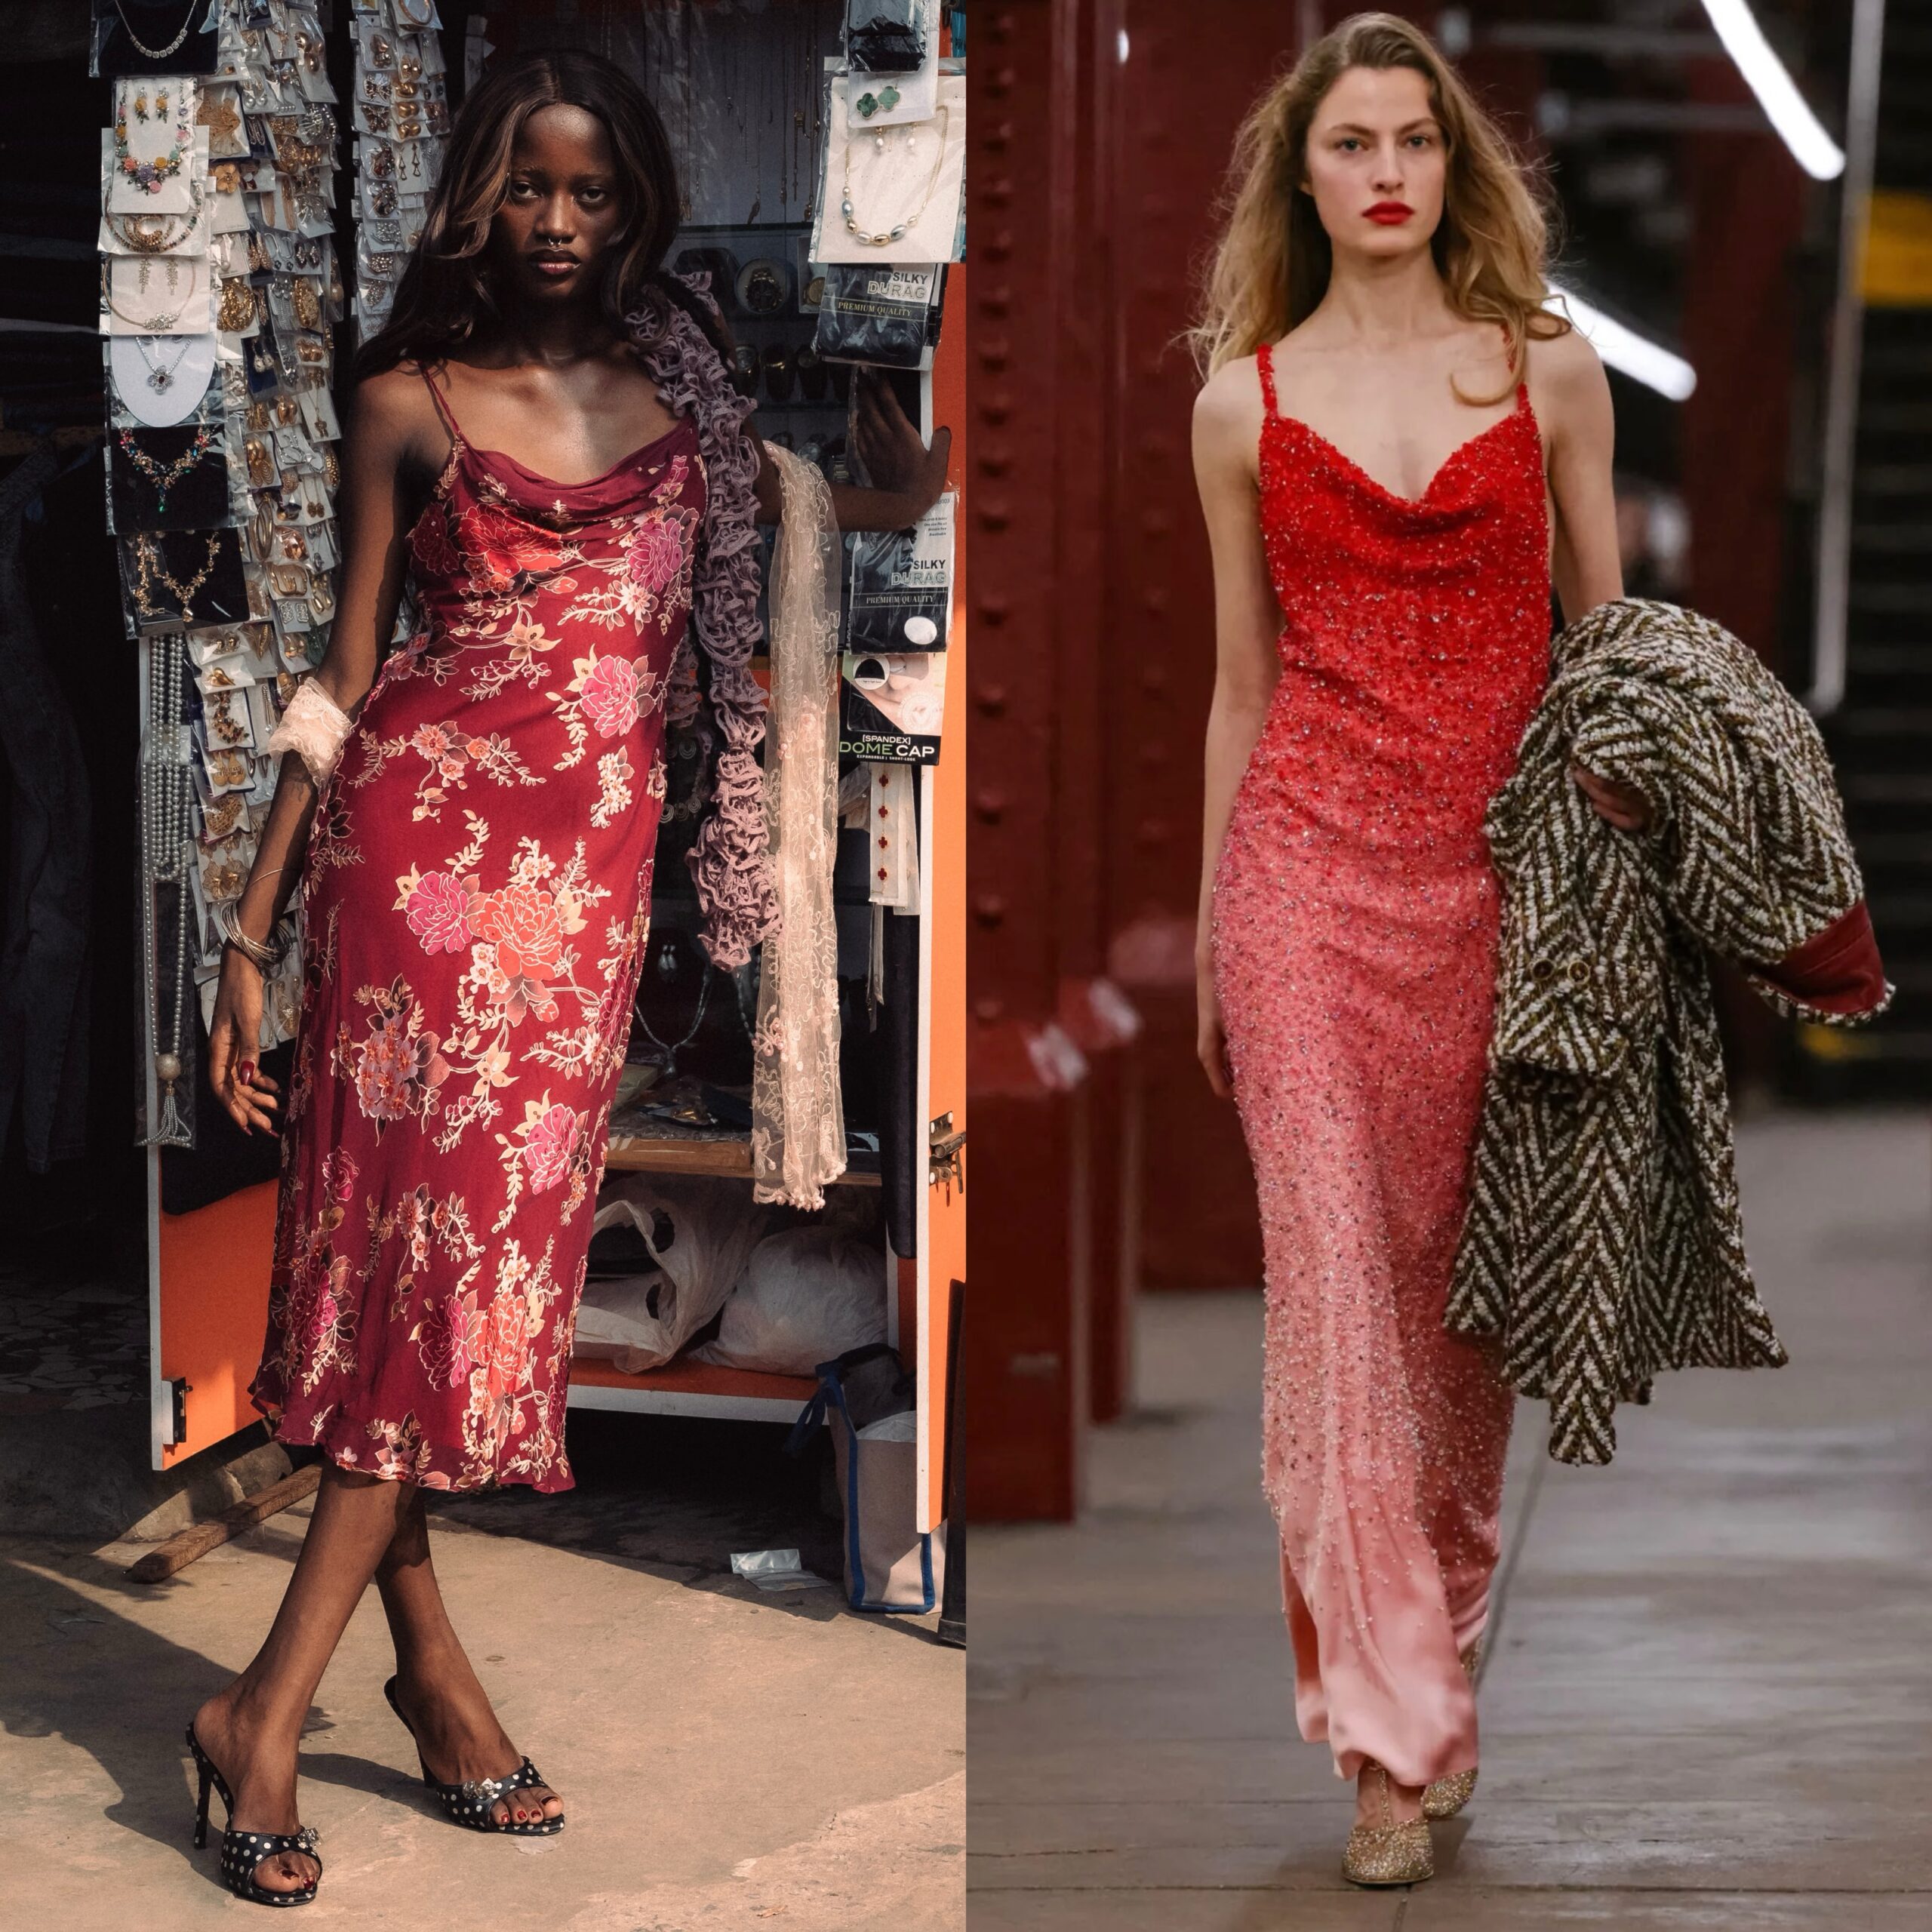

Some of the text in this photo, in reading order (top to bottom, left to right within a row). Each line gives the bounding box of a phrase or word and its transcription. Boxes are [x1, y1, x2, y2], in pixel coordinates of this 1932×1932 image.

[893, 272, 928, 285] SILKY
[867, 280, 927, 300] DURAG
[838, 301, 912, 317] PREMIUM QUALITY
[913, 559, 946, 570] SILKY
[891, 571, 946, 586] DURAG
[866, 595, 934, 605] PREMIUM QUALITY
[862, 734, 911, 745] [SPANDEX]
[839, 741, 935, 758] DOME CAP
